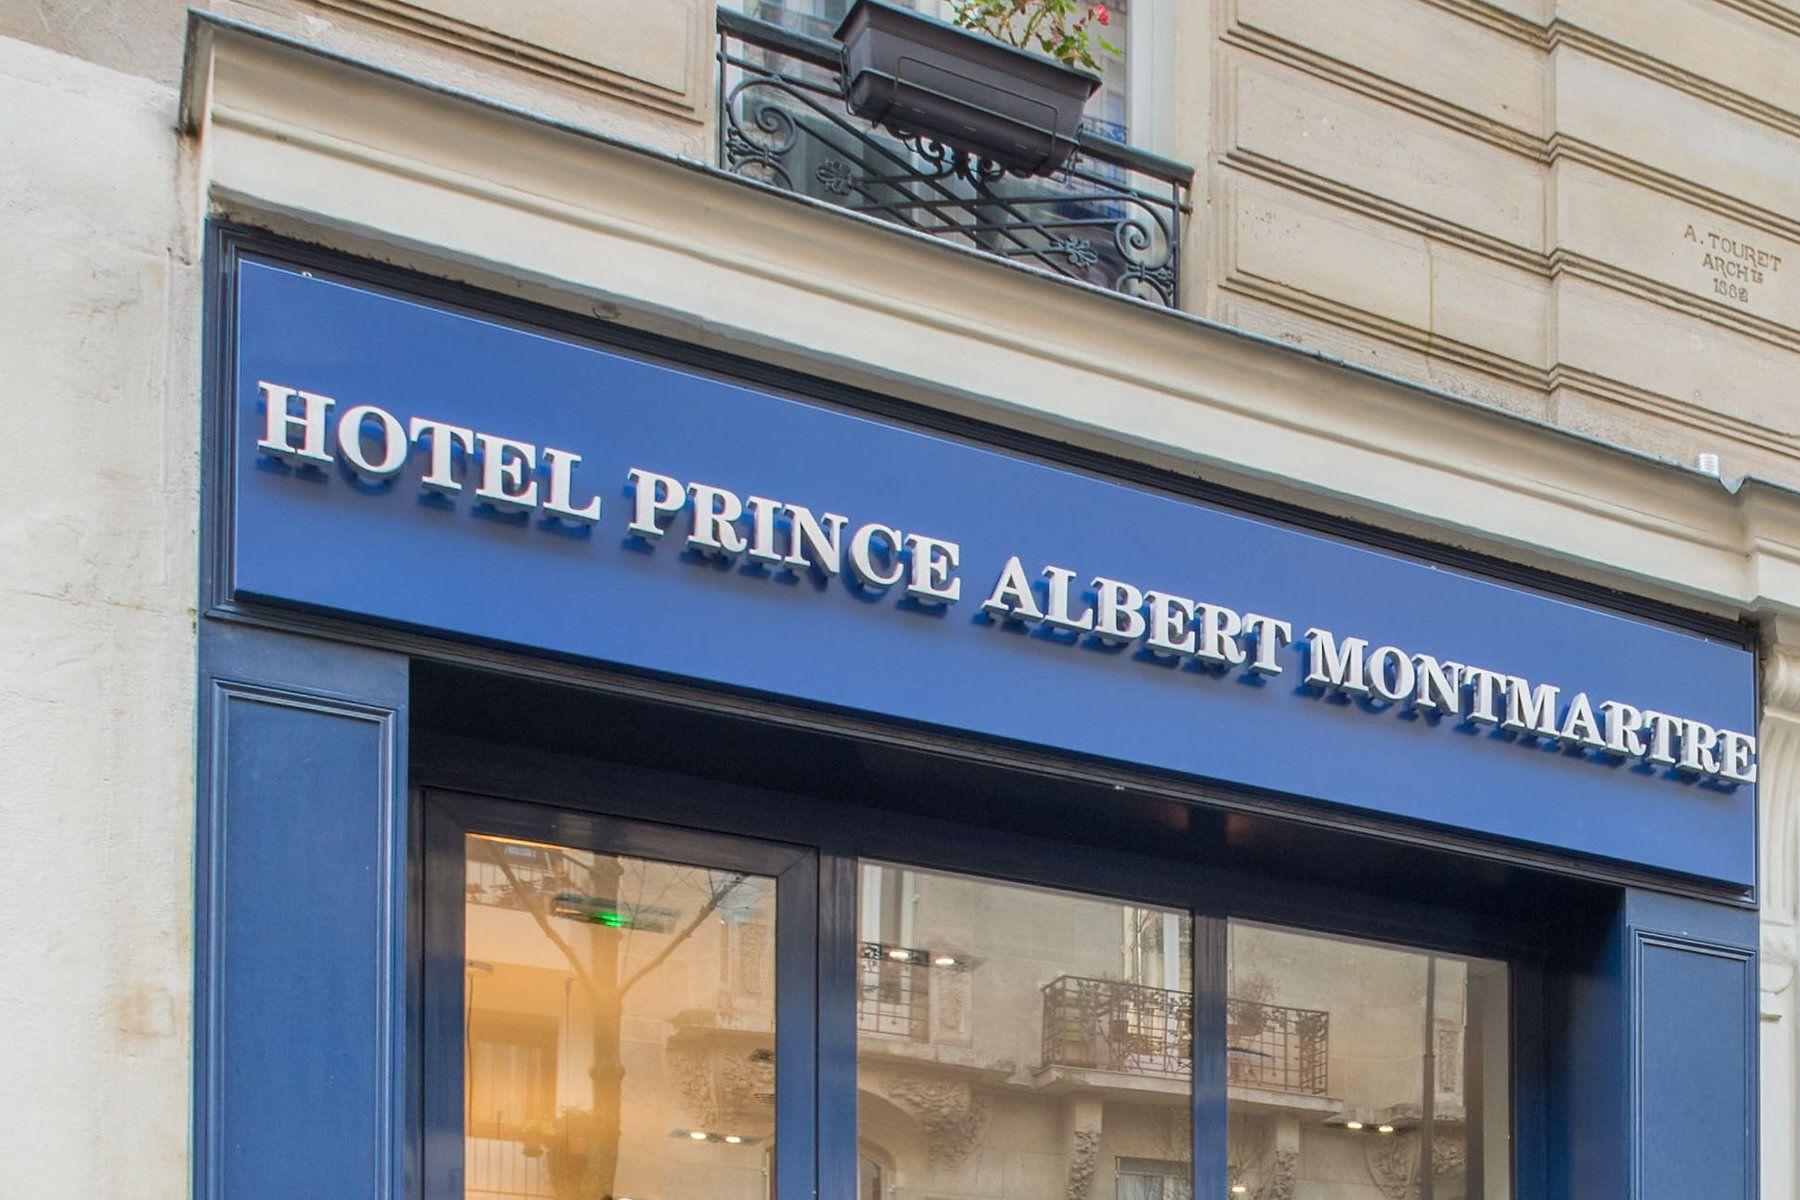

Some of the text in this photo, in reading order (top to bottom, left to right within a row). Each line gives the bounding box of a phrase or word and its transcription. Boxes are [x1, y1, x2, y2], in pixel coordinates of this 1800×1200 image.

[1708, 232, 1781, 271] TOURET
[257, 380, 1757, 784] HOTEL PRINCE ALBERT MONTMARTRE
